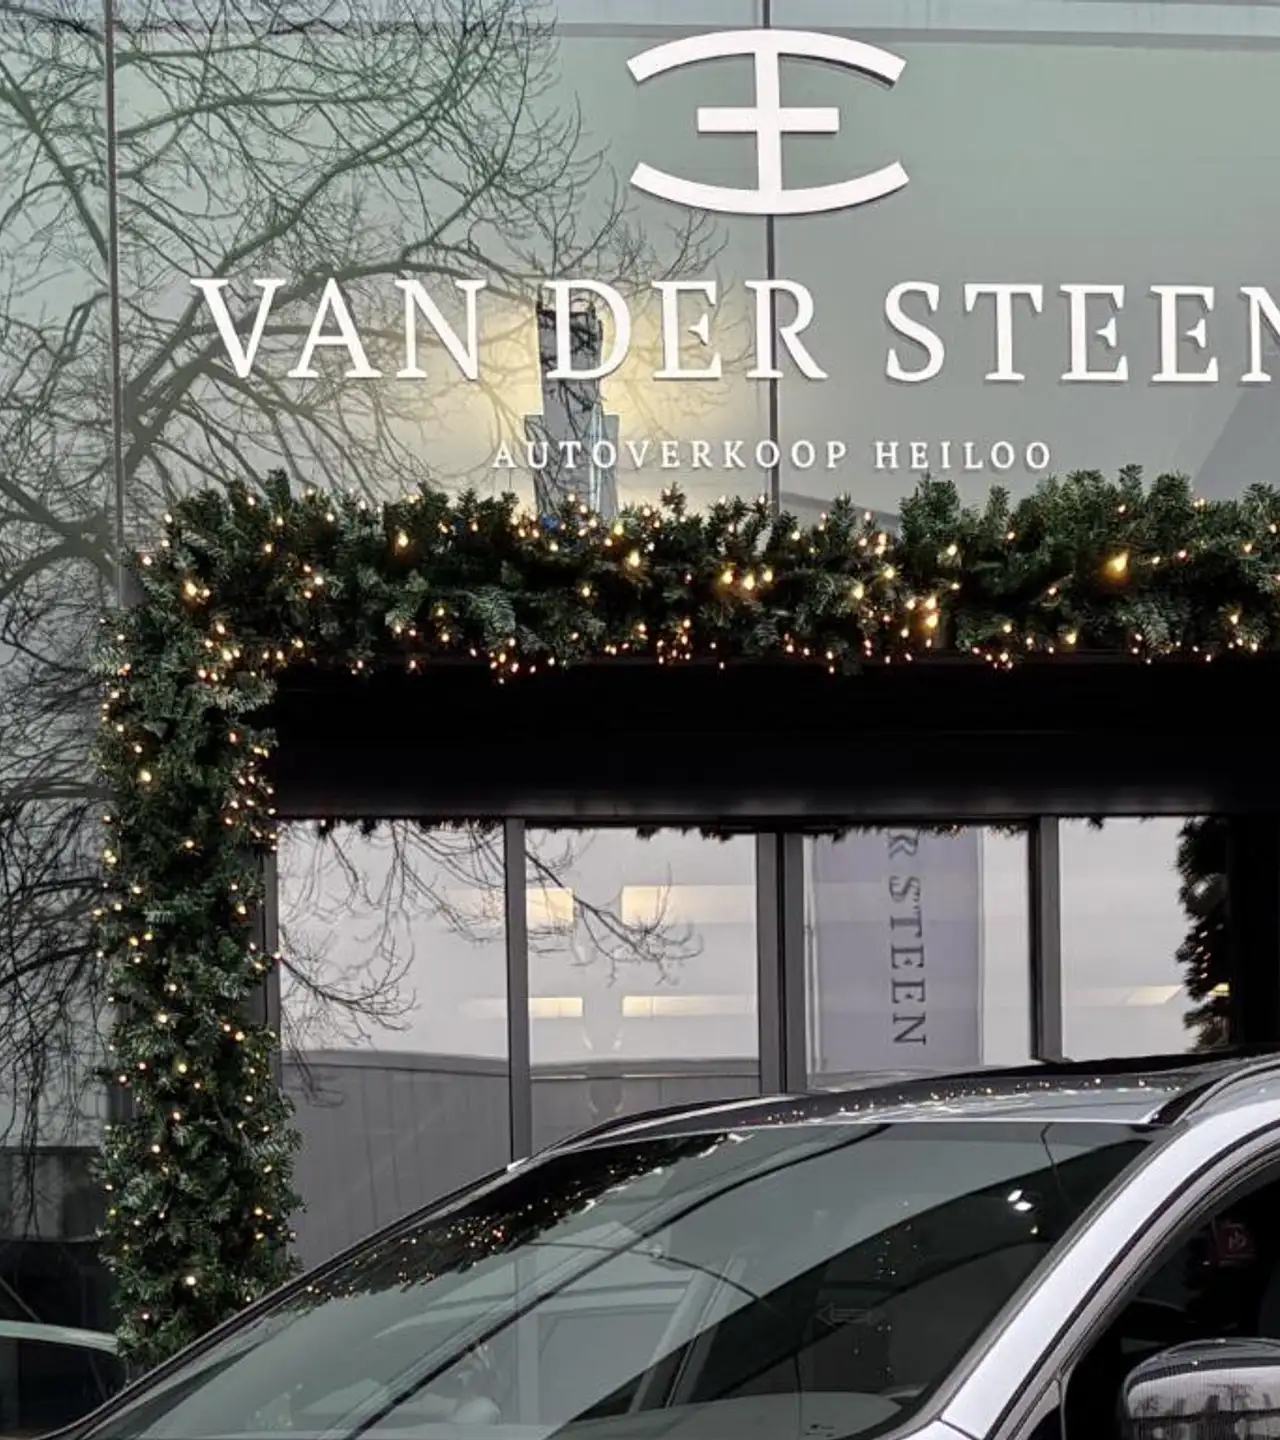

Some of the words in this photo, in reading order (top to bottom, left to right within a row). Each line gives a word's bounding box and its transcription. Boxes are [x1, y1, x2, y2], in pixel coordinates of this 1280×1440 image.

[191, 277, 485, 381] VAN
[541, 280, 828, 382] DER
[492, 437, 844, 471] AUTOVERKOOP
[875, 440, 1051, 471] HEILOO
[889, 875, 926, 1046] STEEN
